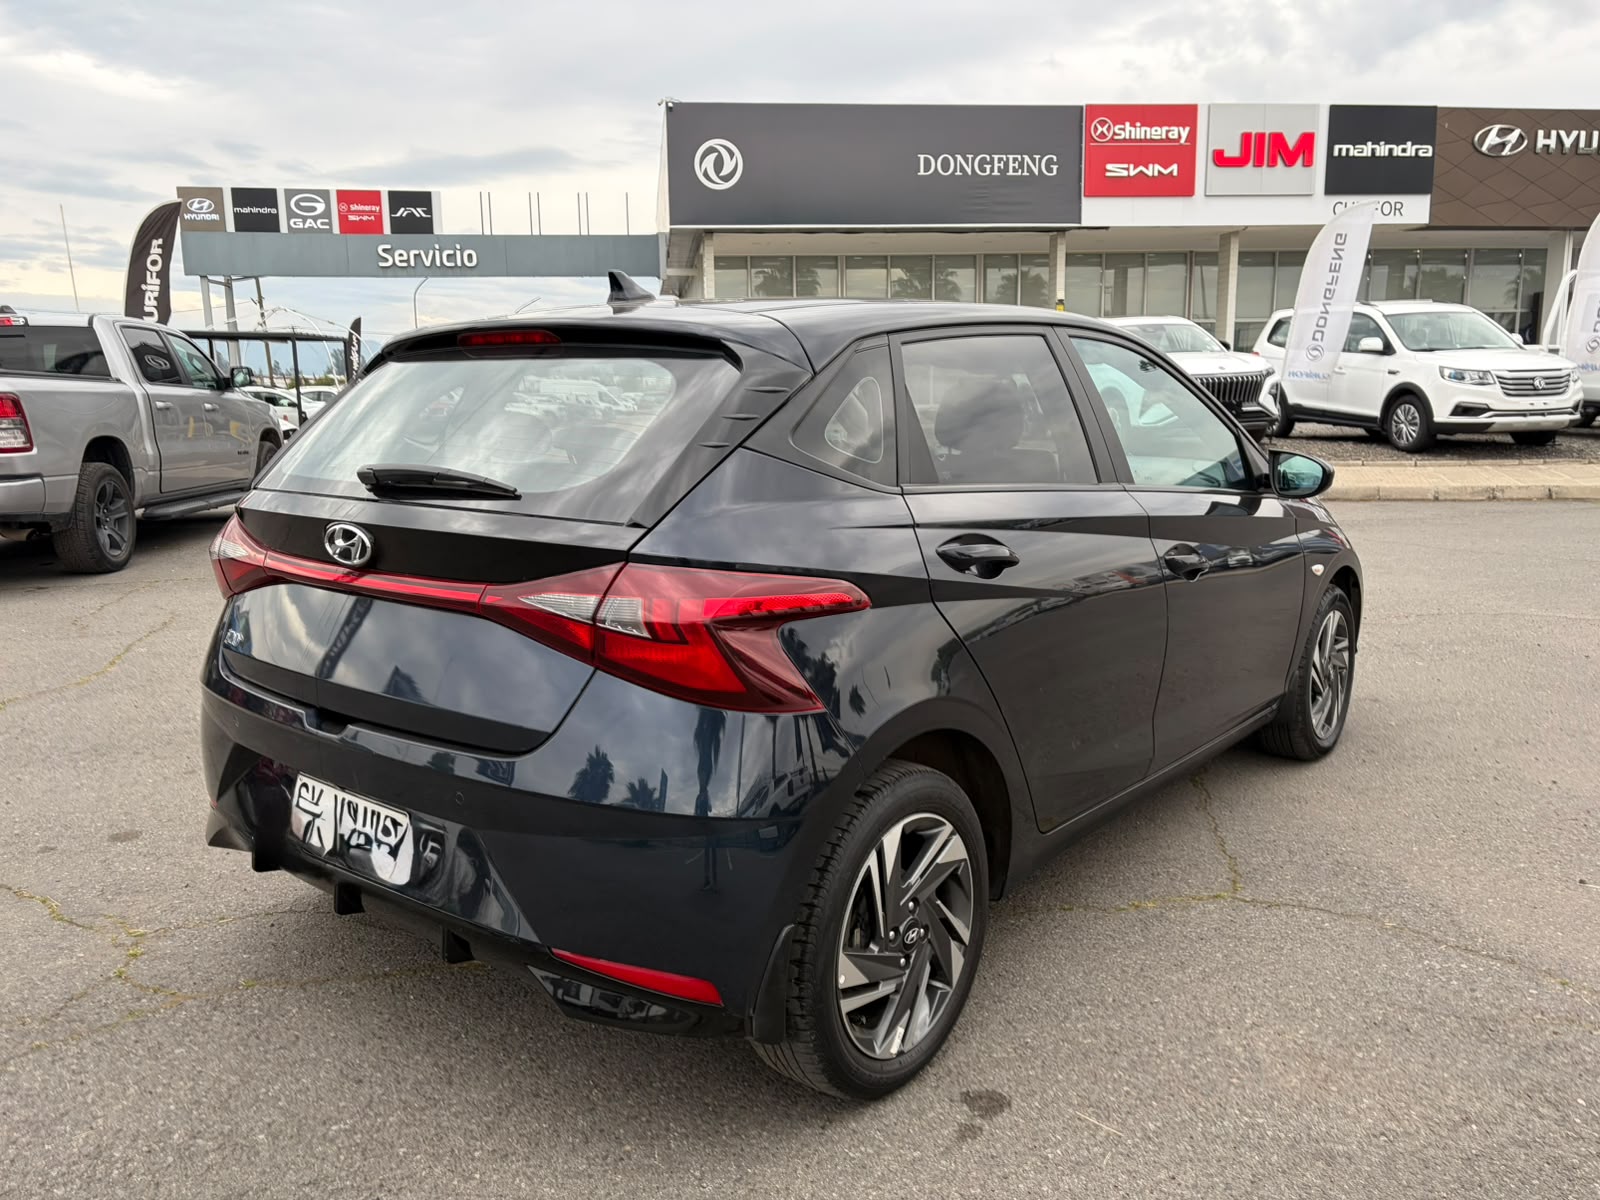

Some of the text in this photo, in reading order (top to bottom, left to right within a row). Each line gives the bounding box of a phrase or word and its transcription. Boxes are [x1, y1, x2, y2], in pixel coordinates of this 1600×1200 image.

[1213, 132, 1315, 167] JIM
[1333, 141, 1433, 158] mahindra
[1535, 129, 1600, 155] HYU
[917, 154, 1059, 176] DONGFENG
[1105, 163, 1178, 177] SWM
[183, 213, 220, 221] HYUNDAI
[233, 206, 278, 214] mahindra
[290, 218, 330, 229] GAC
[377, 243, 478, 267] Servicio
